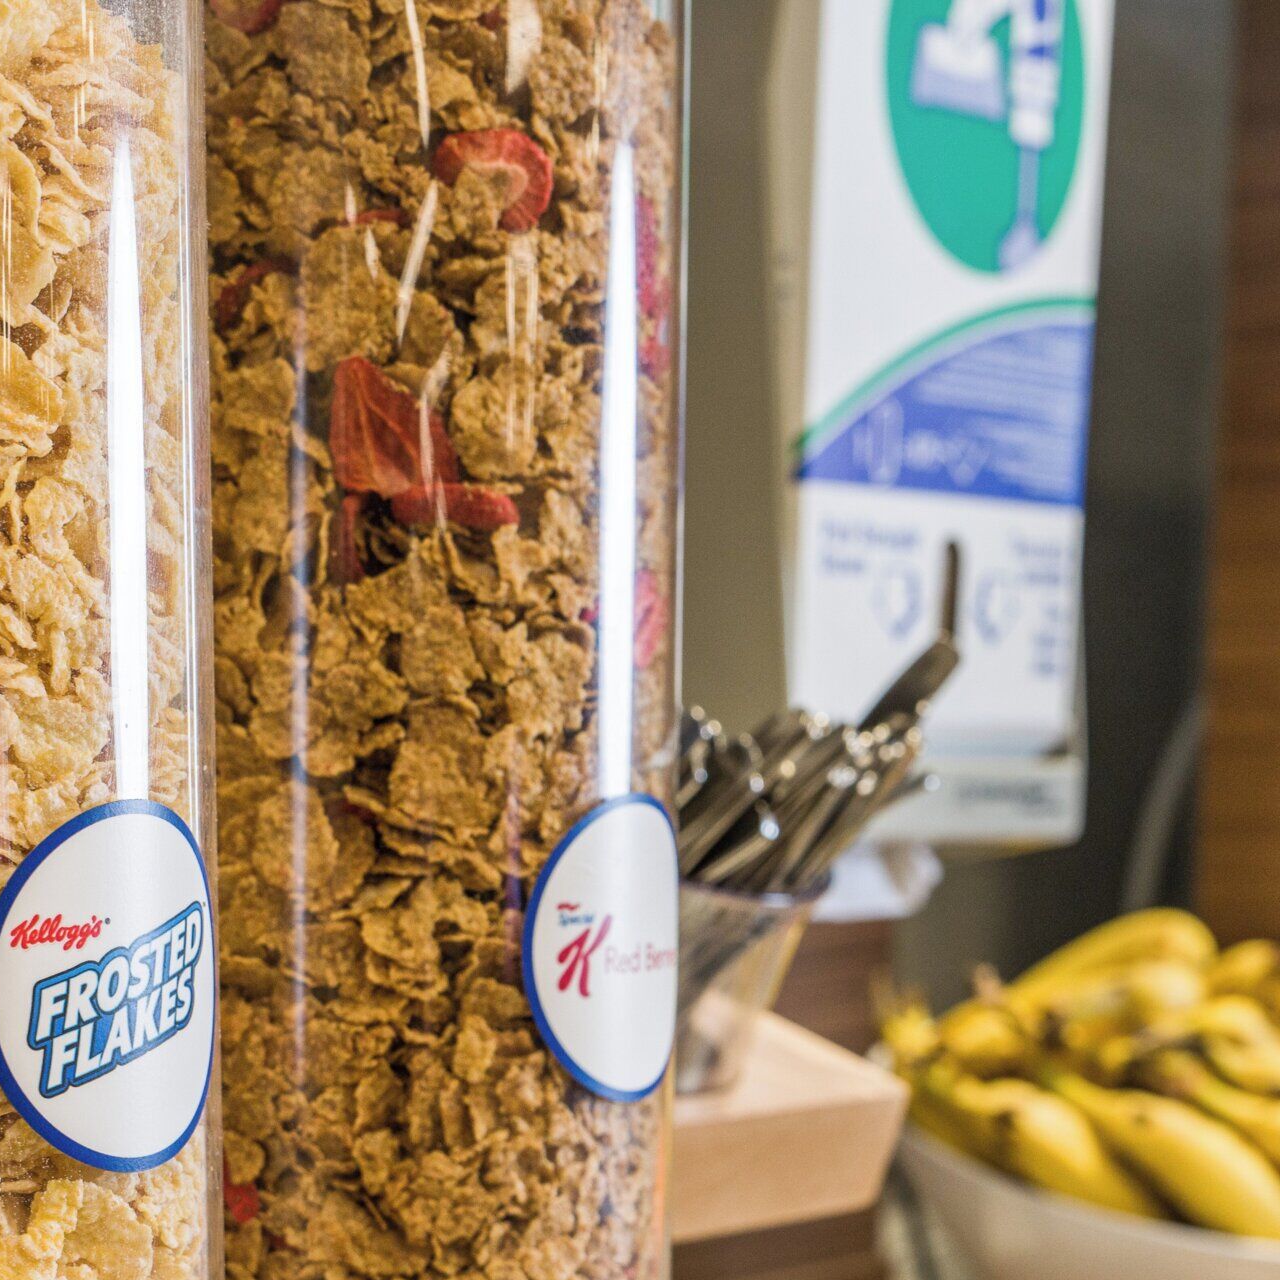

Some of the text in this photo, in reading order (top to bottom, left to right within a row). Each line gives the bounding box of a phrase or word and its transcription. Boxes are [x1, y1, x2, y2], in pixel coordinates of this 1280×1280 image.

[10, 913, 103, 951] Kellogg's
[31, 905, 204, 1046] FROSTED
[557, 913, 612, 997] K
[43, 965, 194, 1094] FLAKES
